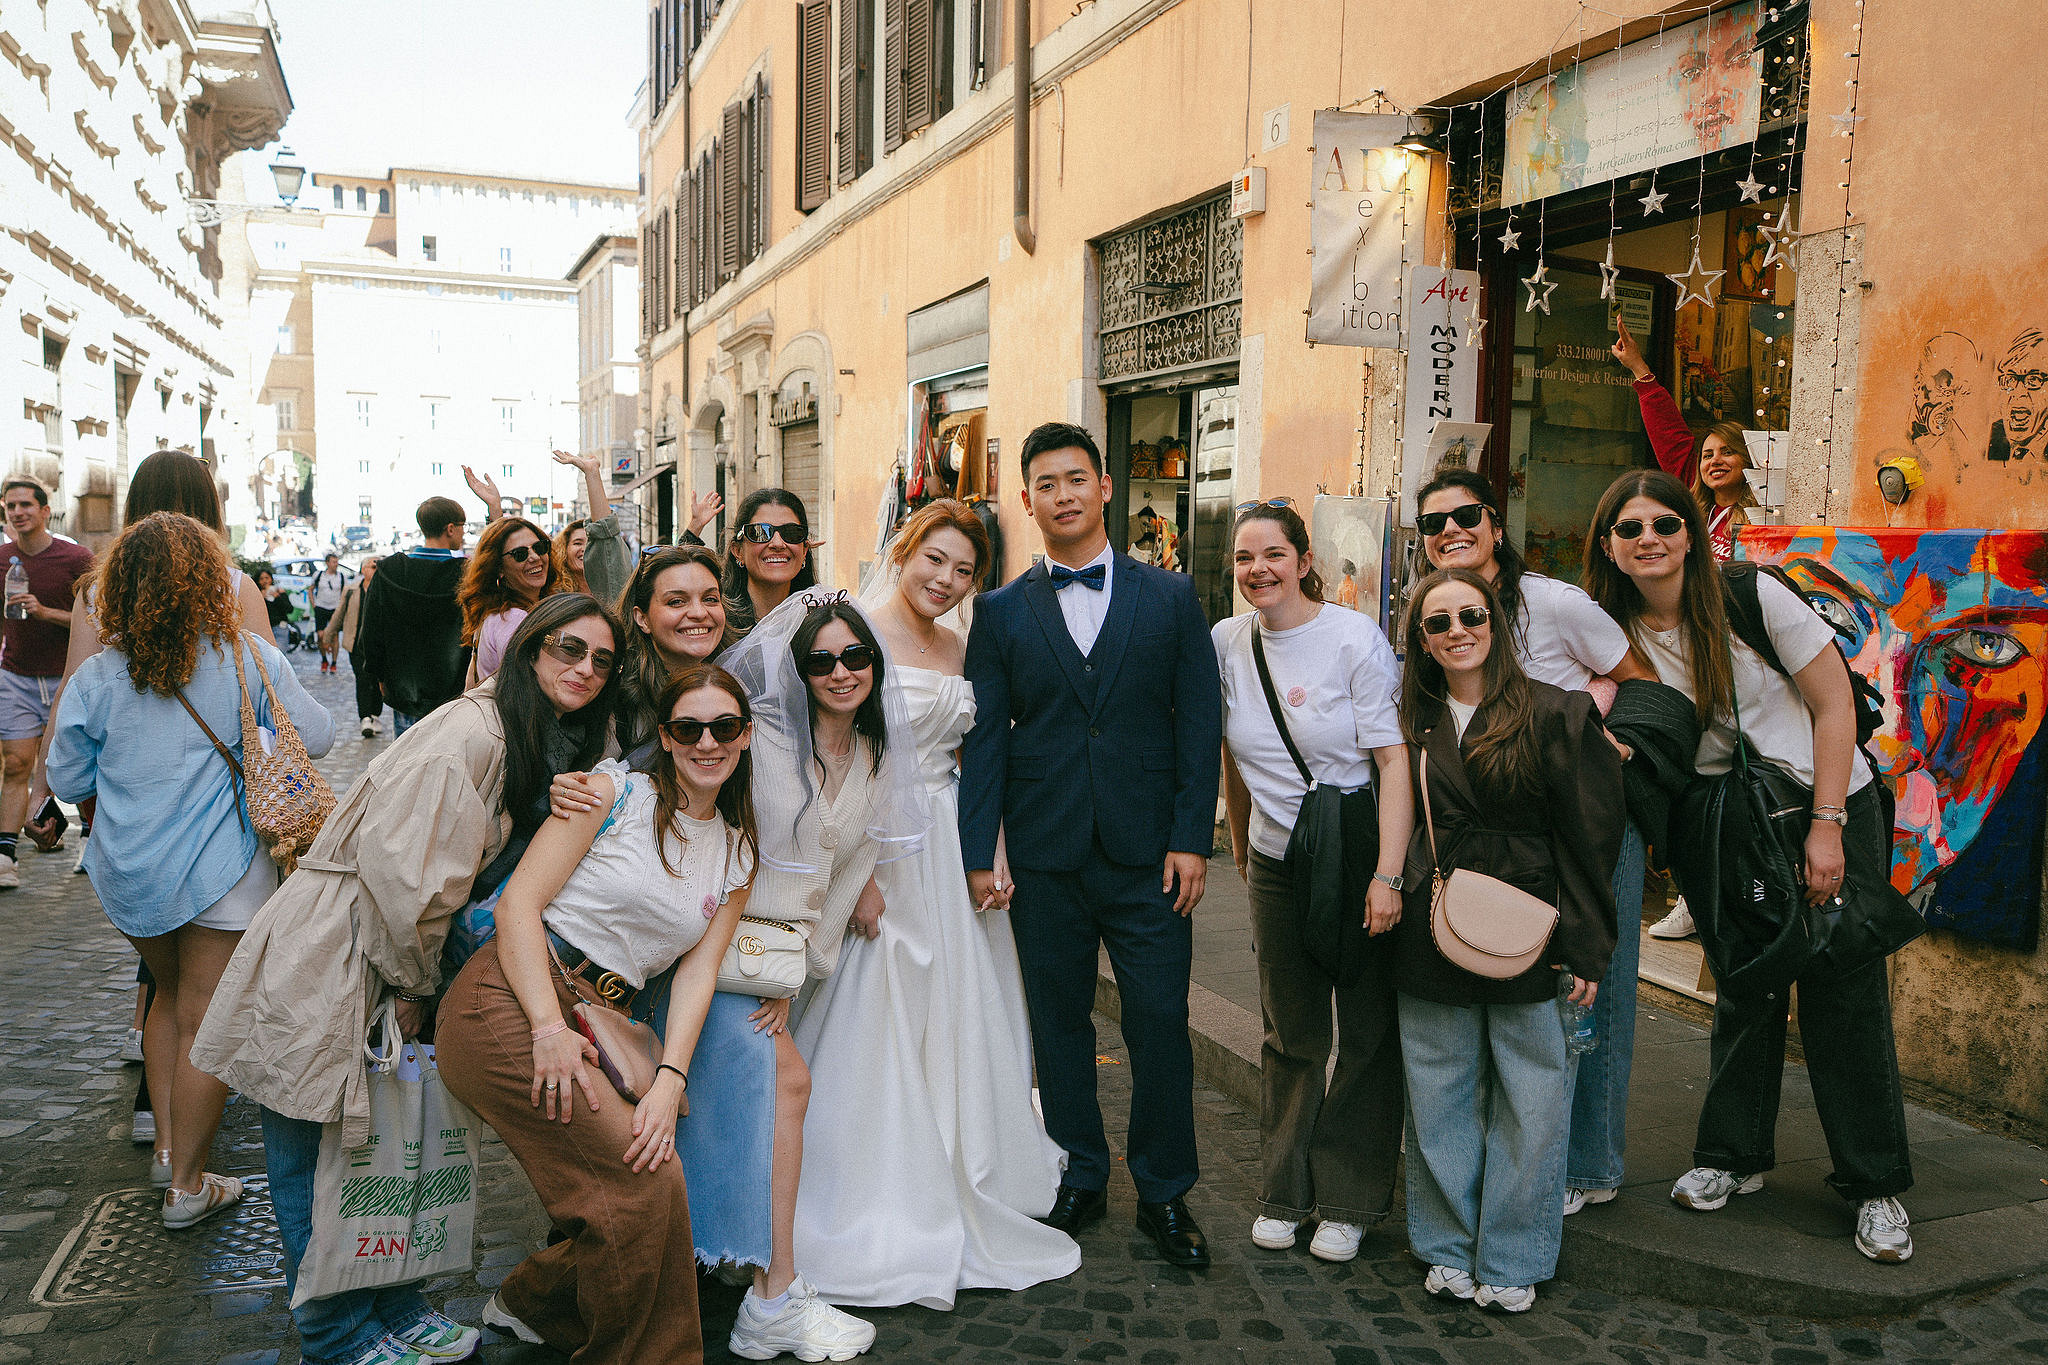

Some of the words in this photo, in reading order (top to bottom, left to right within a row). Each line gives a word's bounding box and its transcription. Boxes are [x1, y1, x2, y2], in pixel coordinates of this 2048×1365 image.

[1271, 113, 1282, 143] 6
[1421, 276, 1470, 305] Art
[1427, 324, 1458, 434] MODERN
[1521, 363, 1558, 380] Interior
[1560, 367, 1590, 386] Design
[1592, 372, 1601, 384] &
[1603, 371, 1637, 387] Restau
[440, 1128, 469, 1140] FRUIT
